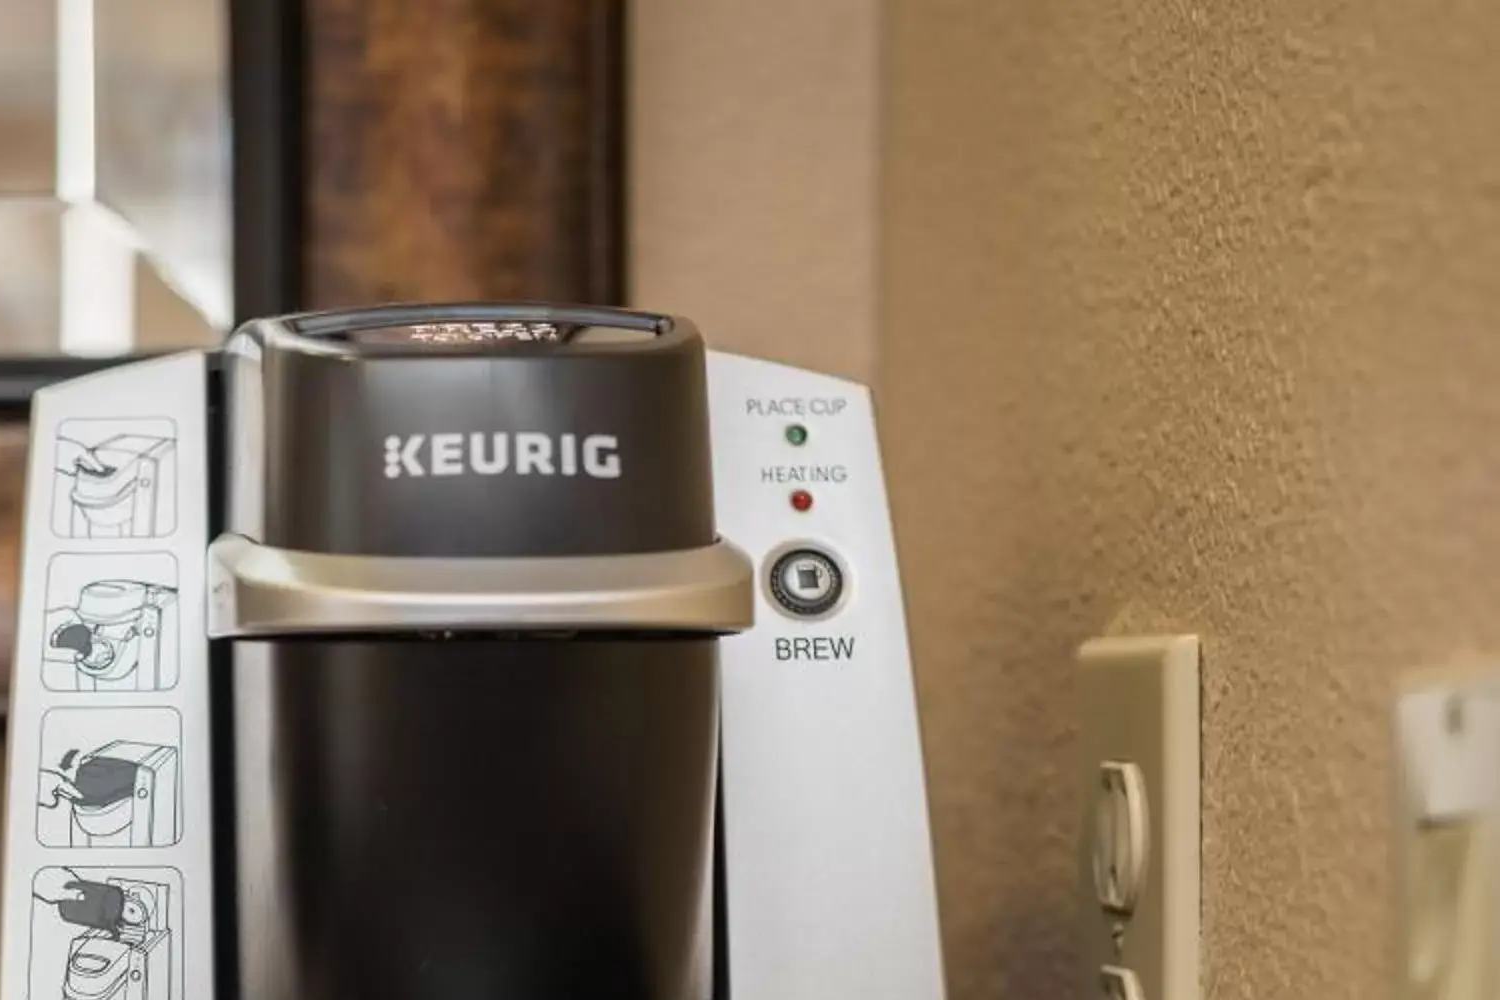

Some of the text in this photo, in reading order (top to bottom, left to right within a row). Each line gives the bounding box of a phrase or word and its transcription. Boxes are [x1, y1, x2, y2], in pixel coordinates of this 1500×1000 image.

[745, 398, 847, 416] PLACE CUP
[385, 431, 621, 479] KEURIG
[760, 465, 847, 482] HEATING
[775, 637, 855, 660] BREW
